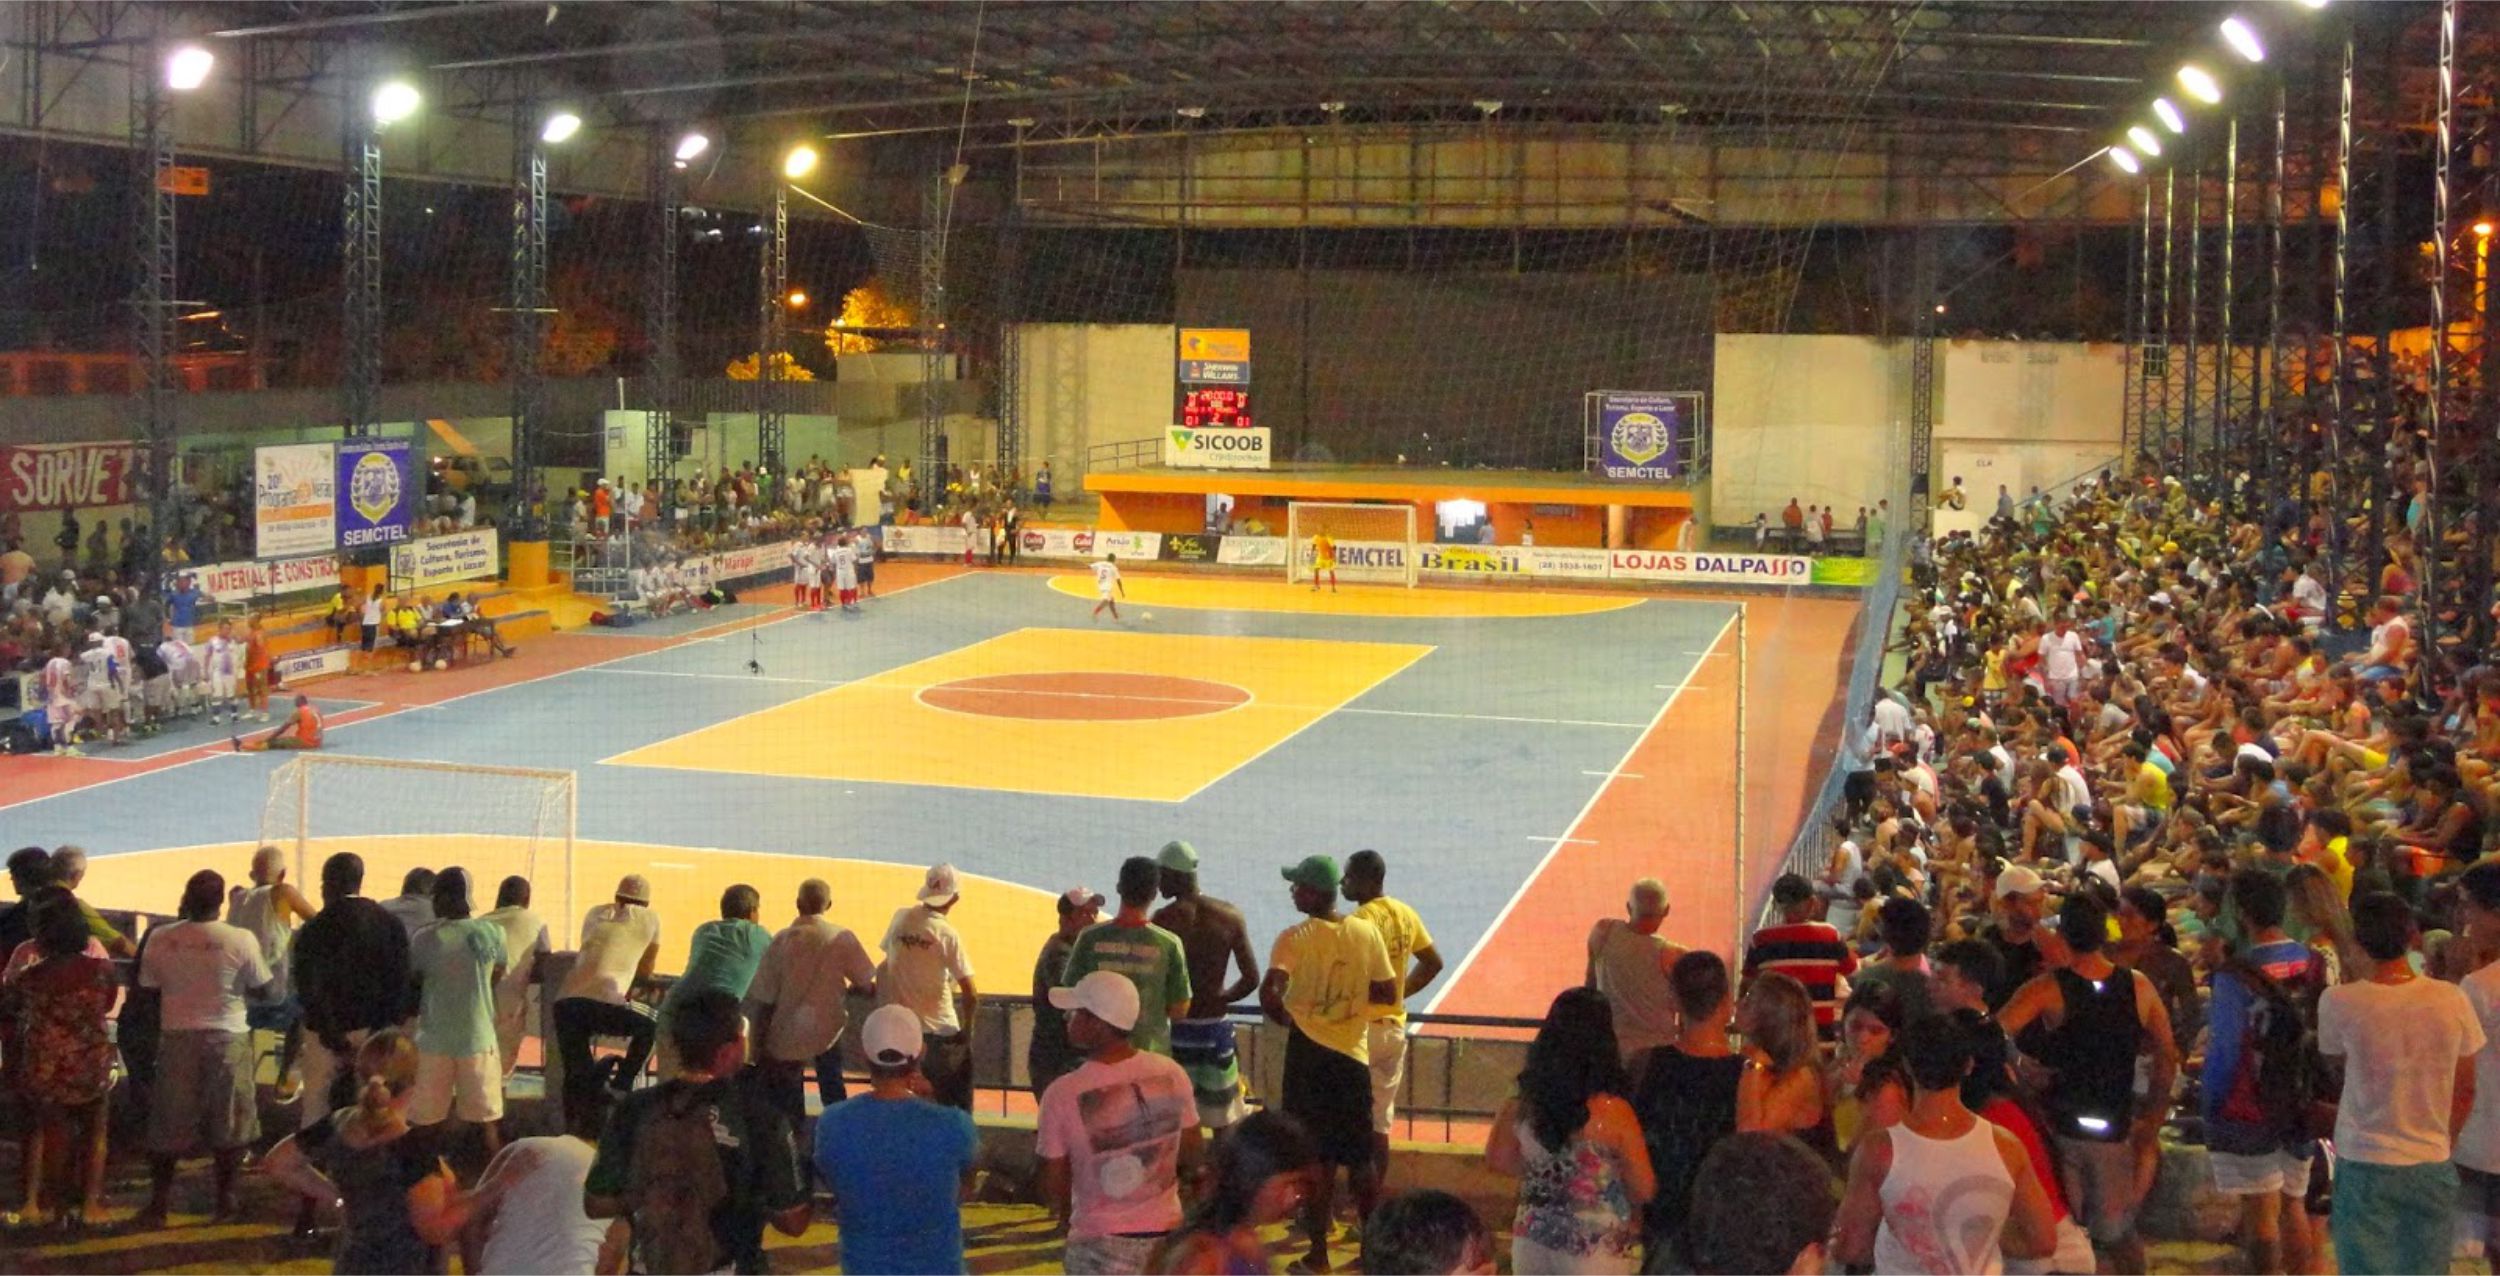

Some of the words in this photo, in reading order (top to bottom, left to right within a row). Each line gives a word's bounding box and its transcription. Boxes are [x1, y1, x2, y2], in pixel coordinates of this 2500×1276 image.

[1194, 435, 1263, 451] SICOOB
[1607, 467, 1672, 479] SEMCTEL
[343, 524, 407, 546] SEMCTEL
[1337, 547, 1404, 567] EMCTEL
[1421, 552, 1520, 572] Brasil
[1612, 554, 1687, 571] LOJAS
[1695, 557, 1806, 576] DALPASSO
[207, 566, 266, 592] MATERIAL
[293, 657, 324, 673] SEMCTEL
